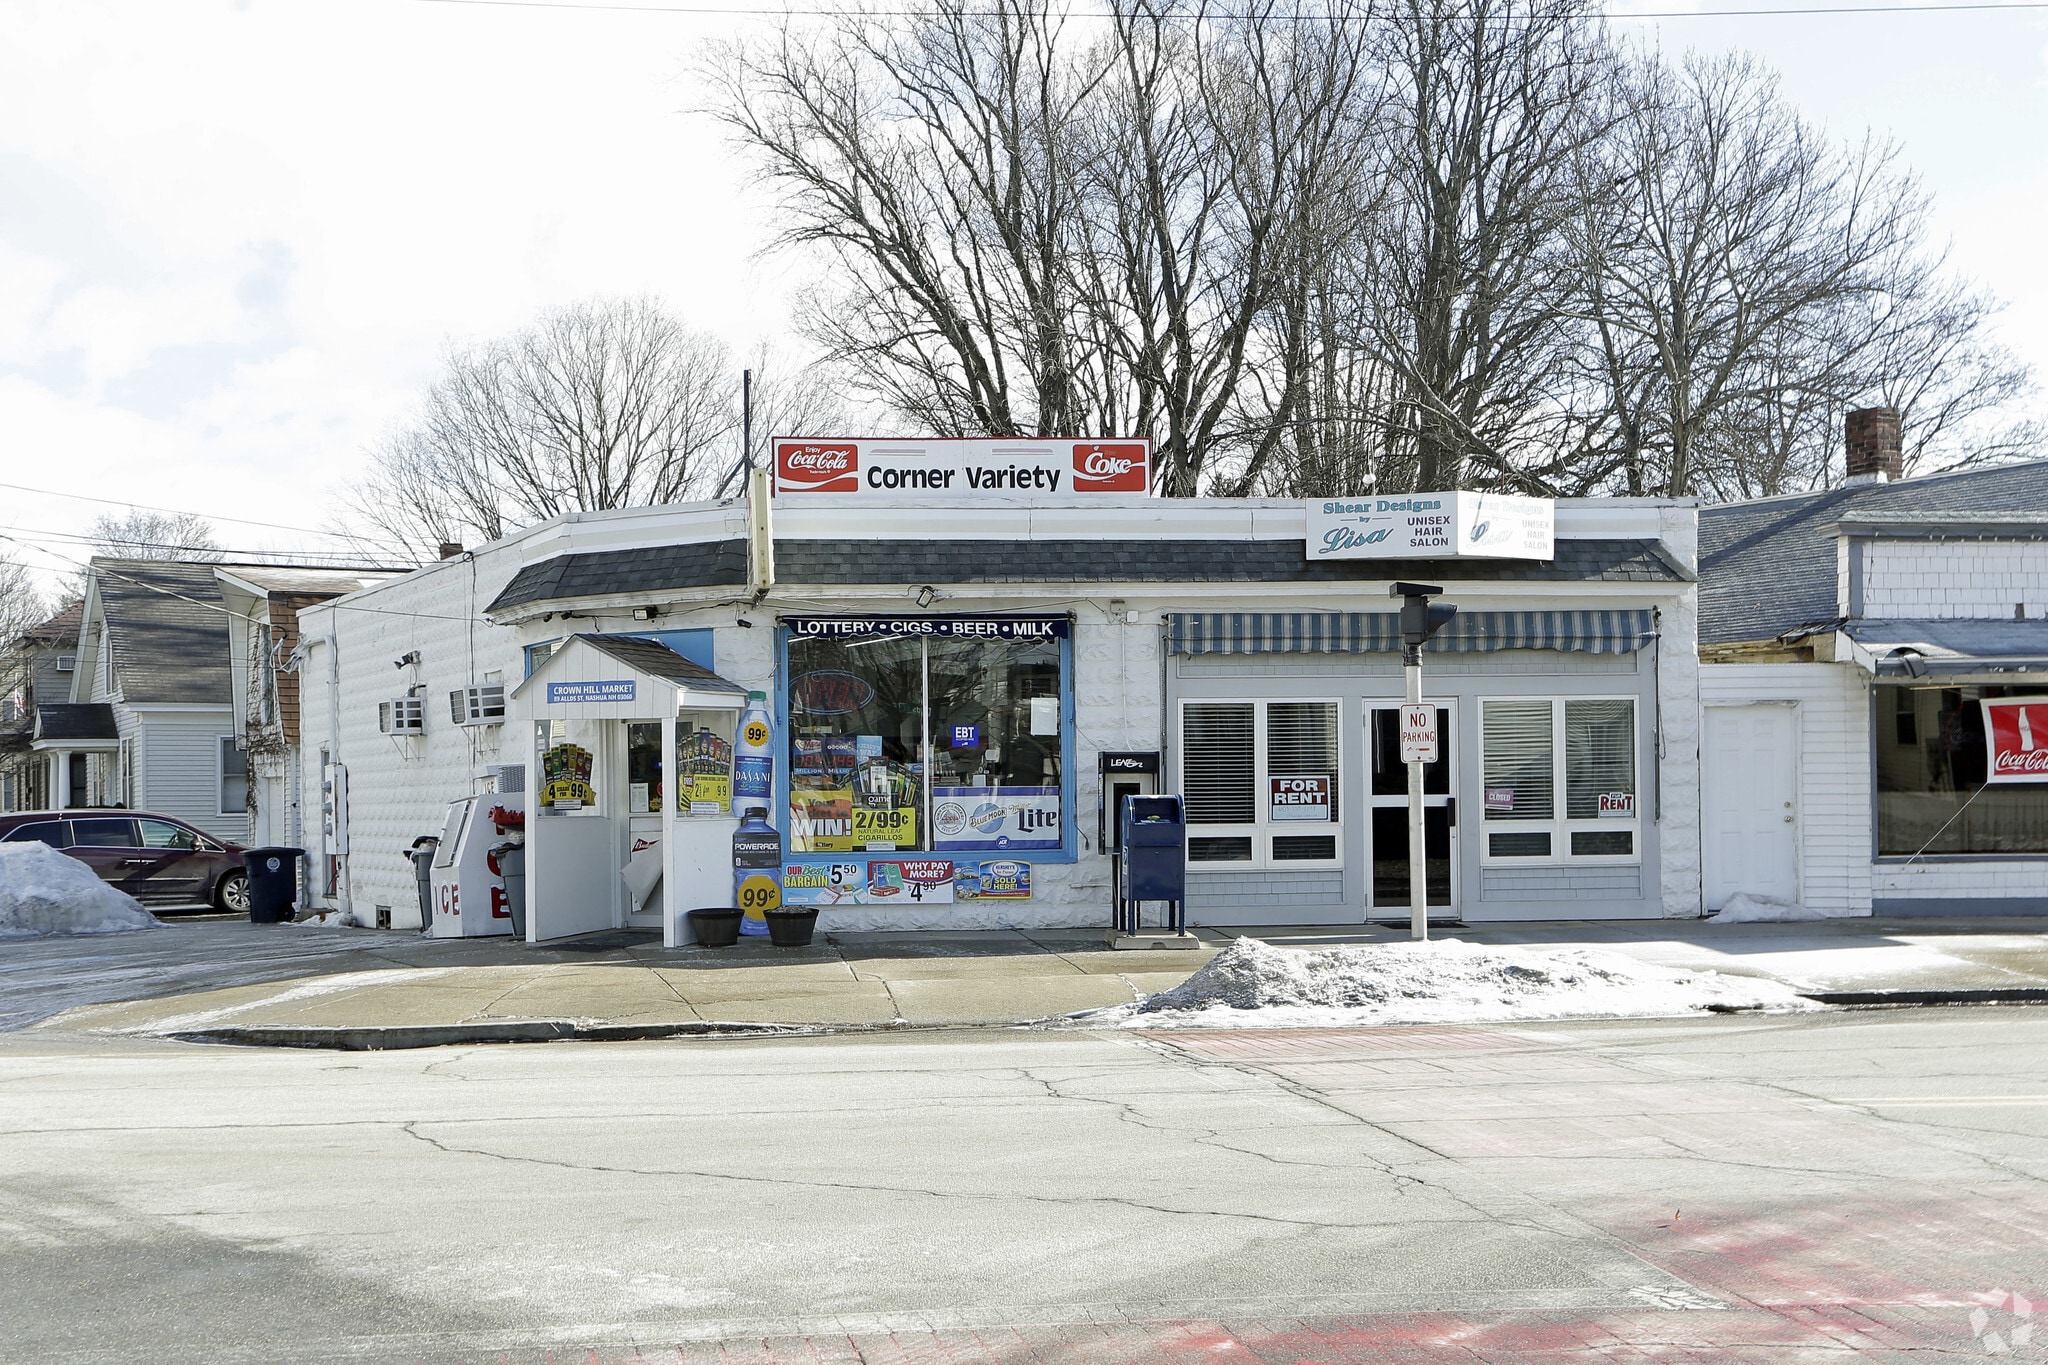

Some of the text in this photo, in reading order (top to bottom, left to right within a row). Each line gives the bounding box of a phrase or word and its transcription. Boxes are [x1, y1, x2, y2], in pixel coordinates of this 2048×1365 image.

[787, 450, 850, 470] Coca-Cola
[1084, 446, 1132, 474] Coke
[867, 464, 1061, 492] Corner Variety
[1323, 498, 1442, 514] Shear Designs
[1359, 516, 1371, 524] by
[1407, 515, 1450, 526] UNISEX
[1522, 520, 1550, 529] UNISEX
[1414, 526, 1443, 536] HAIR
[1527, 530, 1545, 540] HAIR
[1318, 526, 1394, 554] Lisa
[1410, 537, 1449, 548] SALON
[1524, 541, 1548, 550] SALON
[798, 621, 1053, 636] LOTTERY CIGS. BEER MILK
[554, 686, 581, 695] CROWN
[602, 685, 633, 693] MARKET
[1410, 712, 1426, 727] NO
[956, 726, 974, 738] EBT
[1403, 731, 1435, 743] PARKING
[736, 768, 770, 782] DASANI
[549, 784, 555, 798] 4
[571, 783, 587, 798] 99¢
[695, 784, 699, 797] 2
[1280, 780, 1318, 792] FOR
[1274, 792, 1325, 804] RENT
[1600, 796, 1632, 810] RENT
[855, 811, 908, 829] 2/99¢
[970, 809, 1006, 827] BLUE MOON
[1018, 808, 1057, 833] Lite
[791, 818, 852, 836] WIN!
[787, 864, 826, 875] OUR Best
[909, 870, 944, 878] MORE?
[784, 876, 828, 888] BARGAIN
[435, 884, 460, 915] ICE
[743, 888, 775, 907] 99¢
